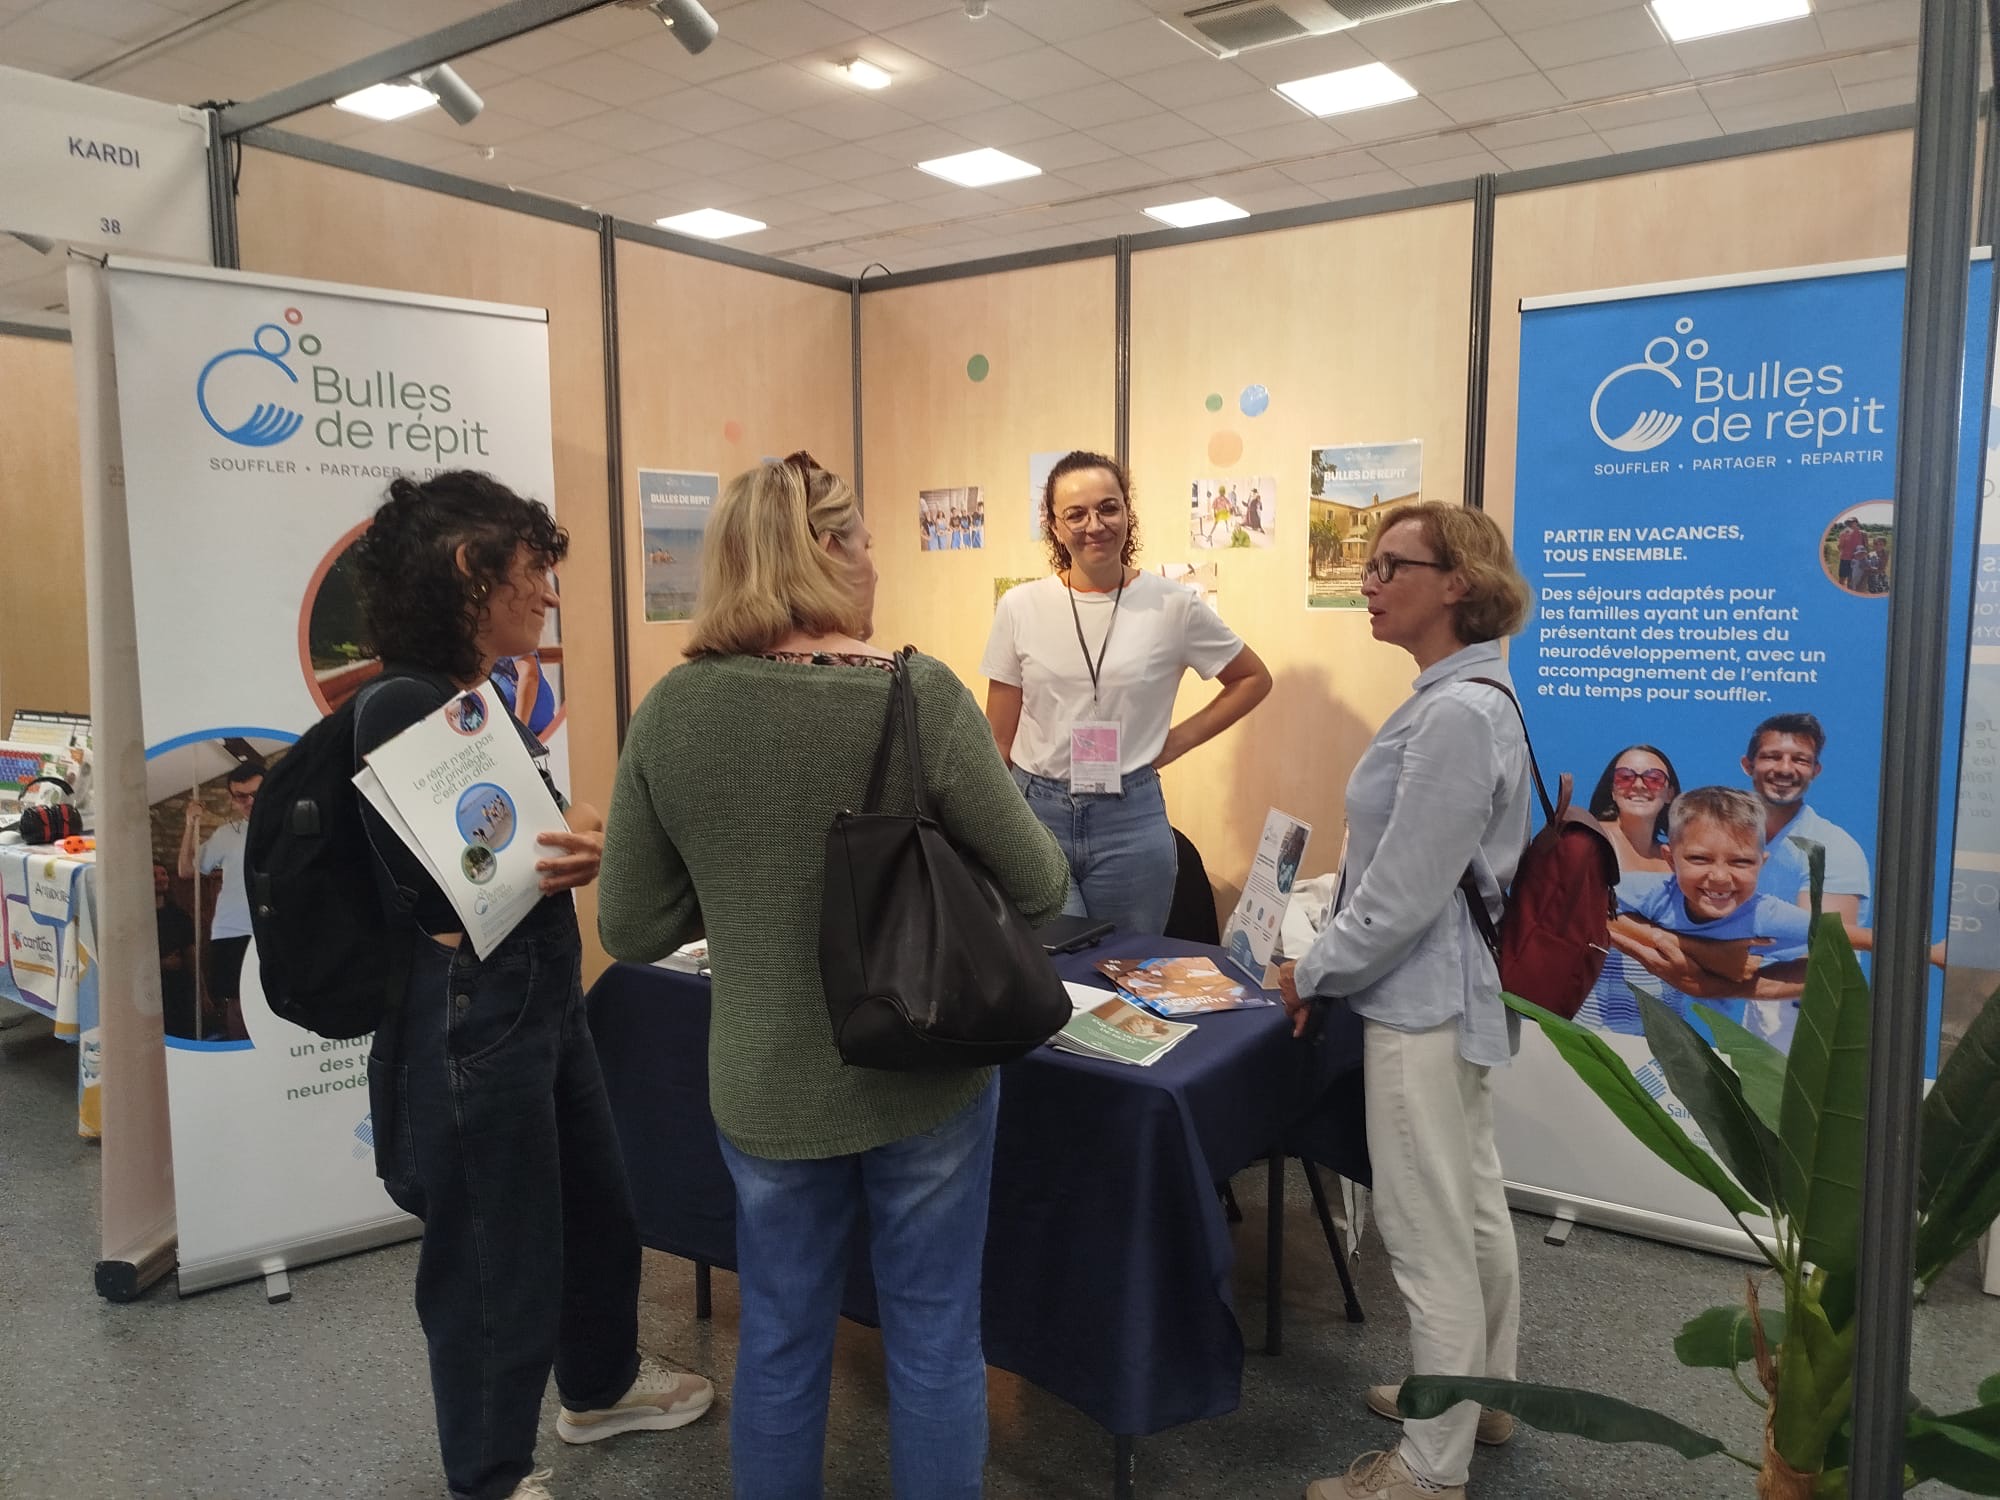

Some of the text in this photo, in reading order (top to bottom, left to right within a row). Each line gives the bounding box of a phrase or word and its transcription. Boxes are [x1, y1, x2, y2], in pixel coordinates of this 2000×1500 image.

[68, 135, 140, 169] KARDI
[100, 216, 121, 235] 38
[312, 364, 452, 414] Bulles
[1695, 360, 1844, 403] Bulles
[1691, 396, 1885, 449] de répit
[314, 410, 490, 464] de répit
[209, 456, 402, 480] SOUFFLER PARTAGER
[1594, 450, 1884, 476] SOUFFLER PARTAGER REPARTIR
[1543, 525, 1745, 544] PARTIR EN VACANCES,
[1543, 546, 1688, 563] TOUS ENSEMBLE.
[1541, 585, 1776, 605] Des séjours adaptés pour
[1540, 605, 1799, 625] les familles ayant un enfant
[1540, 624, 1789, 643] présentant des troubles du
[1539, 644, 1826, 664] neurodéveloppement, avec un
[1538, 665, 1818, 683] accompagnement de l'enfant
[1537, 681, 1772, 703] et du temps pour souffler.
[426, 760, 450, 783] répit
[450, 744, 474, 767] n'est
[474, 733, 495, 753] pas
[430, 778, 445, 793] un
[432, 784, 458, 806] C'est
[459, 774, 473, 788] un
[289, 1043, 315, 1058] un
[319, 1058, 354, 1073] des
[287, 1072, 369, 1101] neurodé
